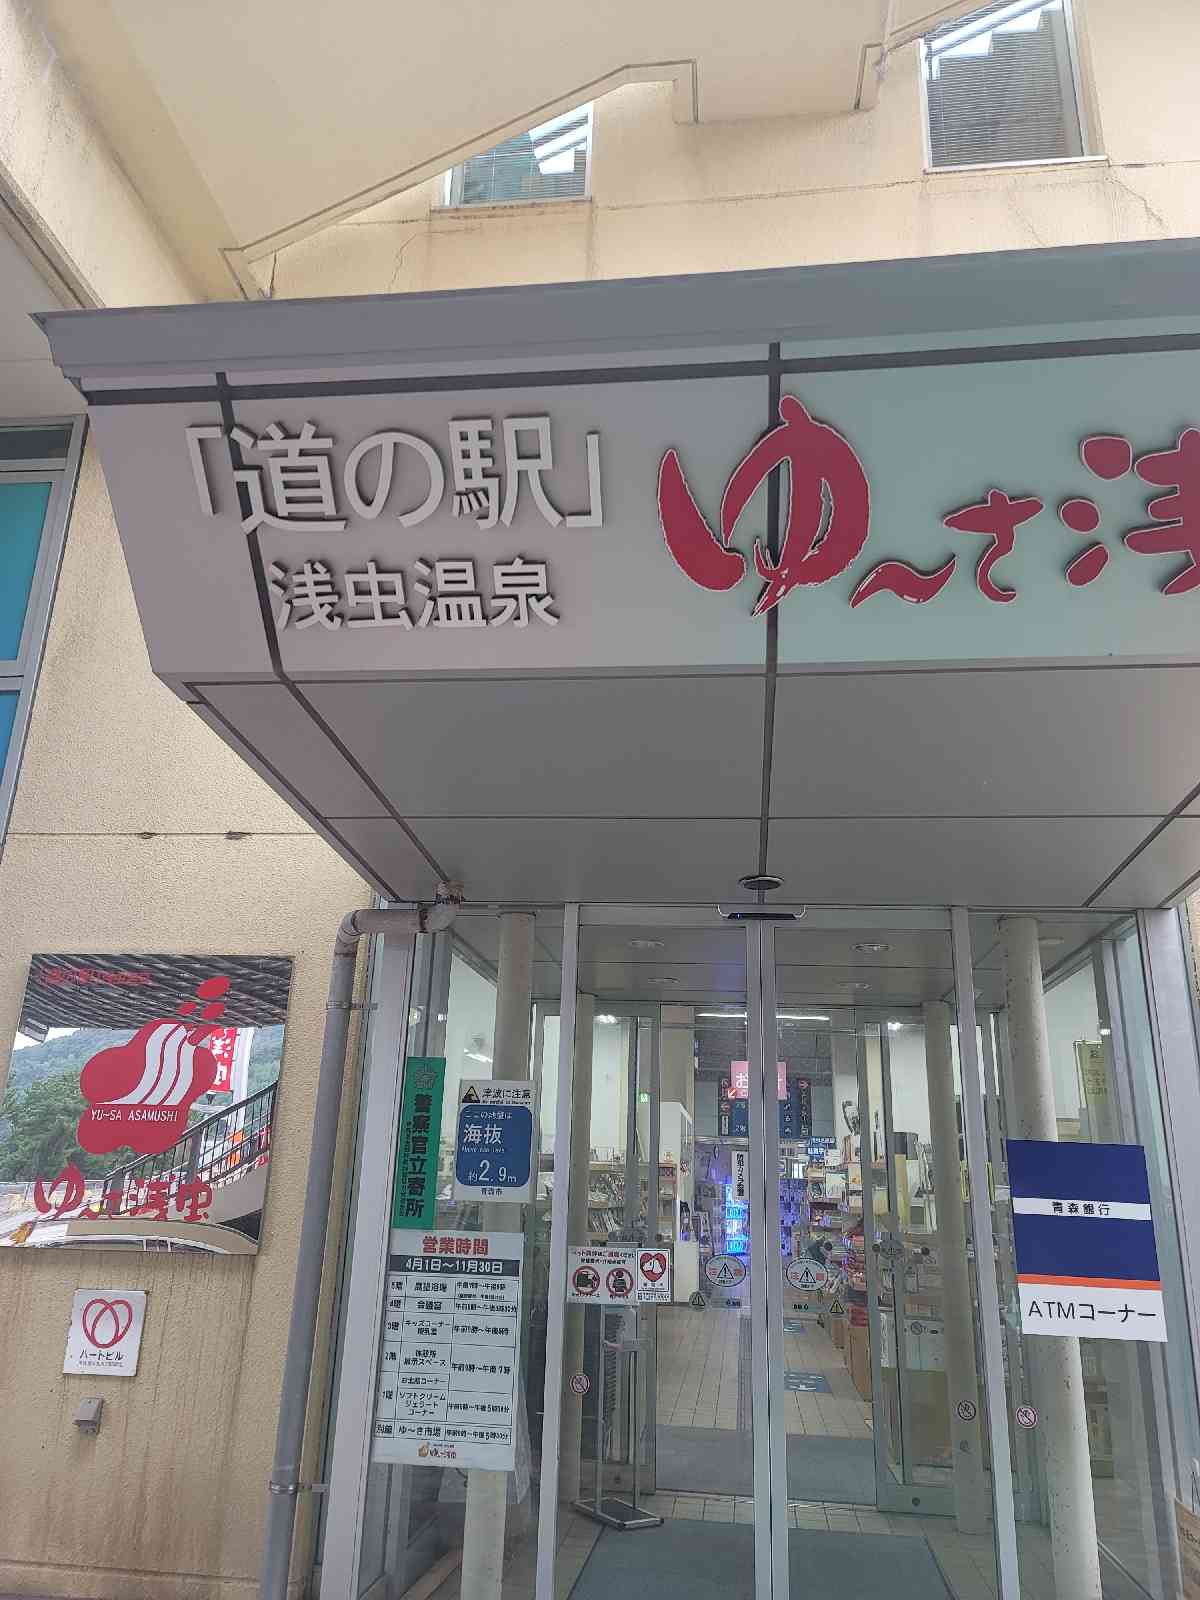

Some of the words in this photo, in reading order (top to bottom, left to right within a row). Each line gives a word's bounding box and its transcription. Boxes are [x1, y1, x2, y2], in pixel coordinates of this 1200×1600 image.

[185, 415, 603, 534] 「道の駅」
[270, 557, 560, 630] 浅虫温泉
[128, 1110, 178, 1123] ASAMUSHI
[463, 1123, 503, 1145] 海抜
[1051, 1201, 1111, 1216] 青森銀行
[422, 1235, 489, 1256] 営業時間
[1027, 1300, 1157, 1323] ATMコーナー
[79, 1348, 124, 1361] ハートビル
[400, 1392, 446, 1401] ソフトクリーム
[407, 1409, 435, 1417] コーナー
